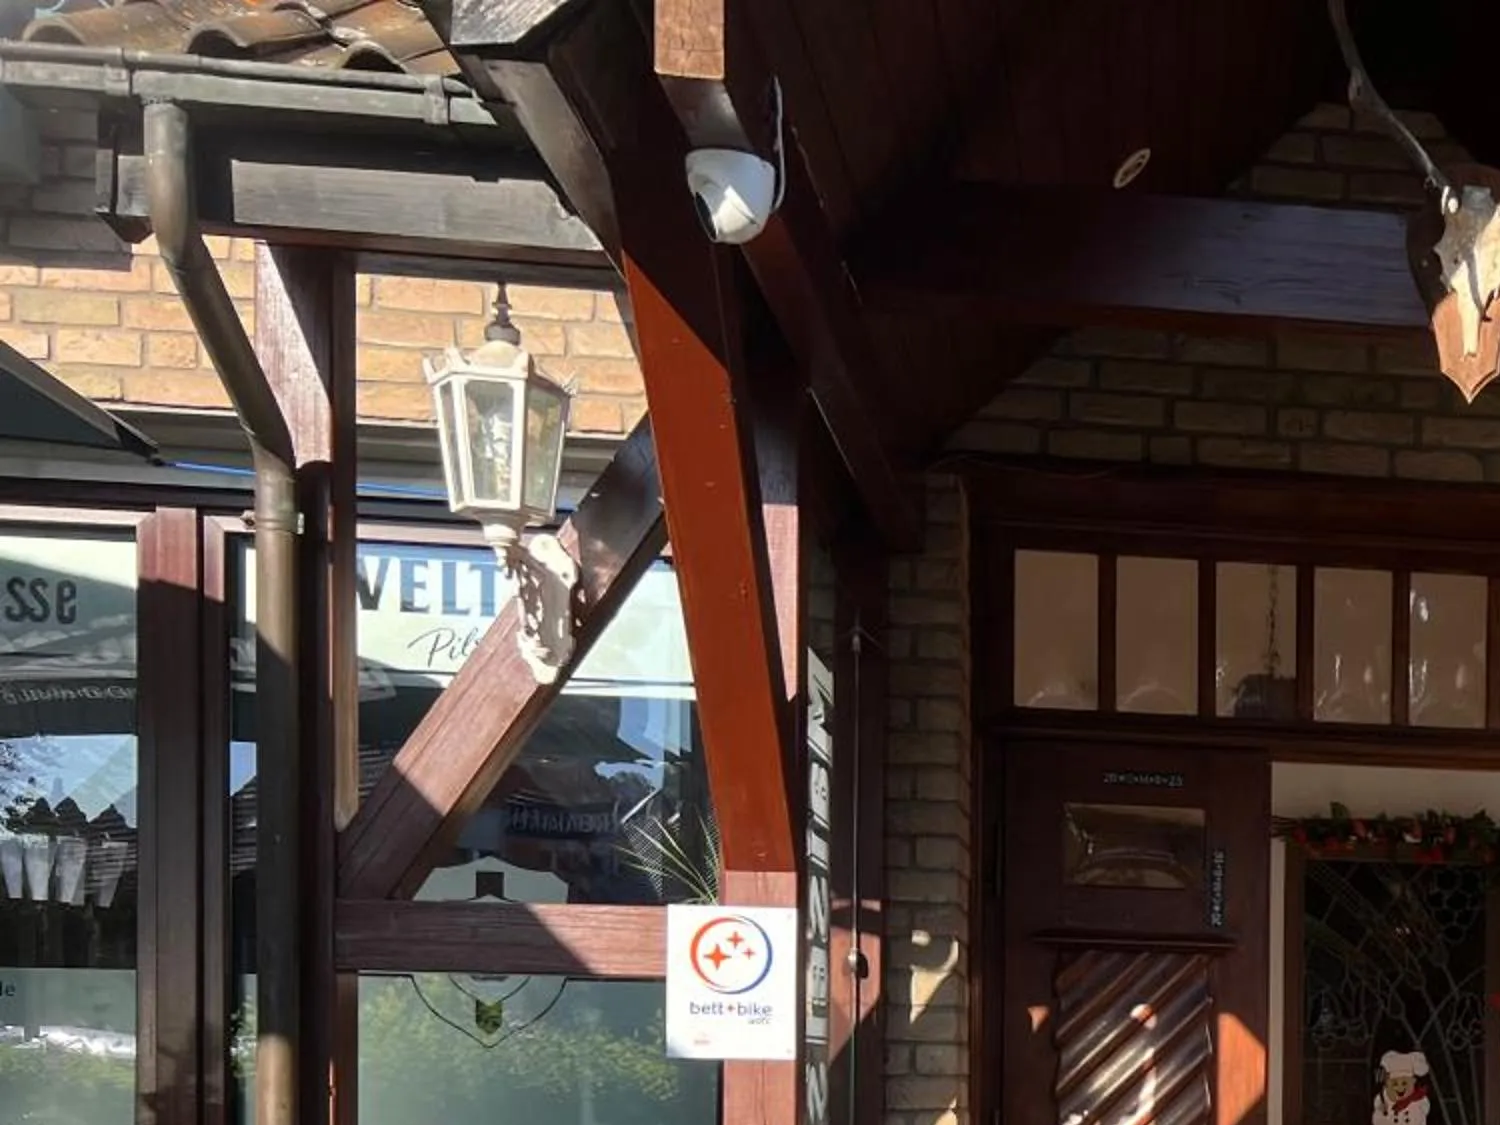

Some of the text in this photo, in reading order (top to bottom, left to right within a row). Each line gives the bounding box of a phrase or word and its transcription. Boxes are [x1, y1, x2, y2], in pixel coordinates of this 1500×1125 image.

[4, 577, 77, 625] sse
[356, 556, 505, 617] VELT
[406, 626, 480, 668] Pil
